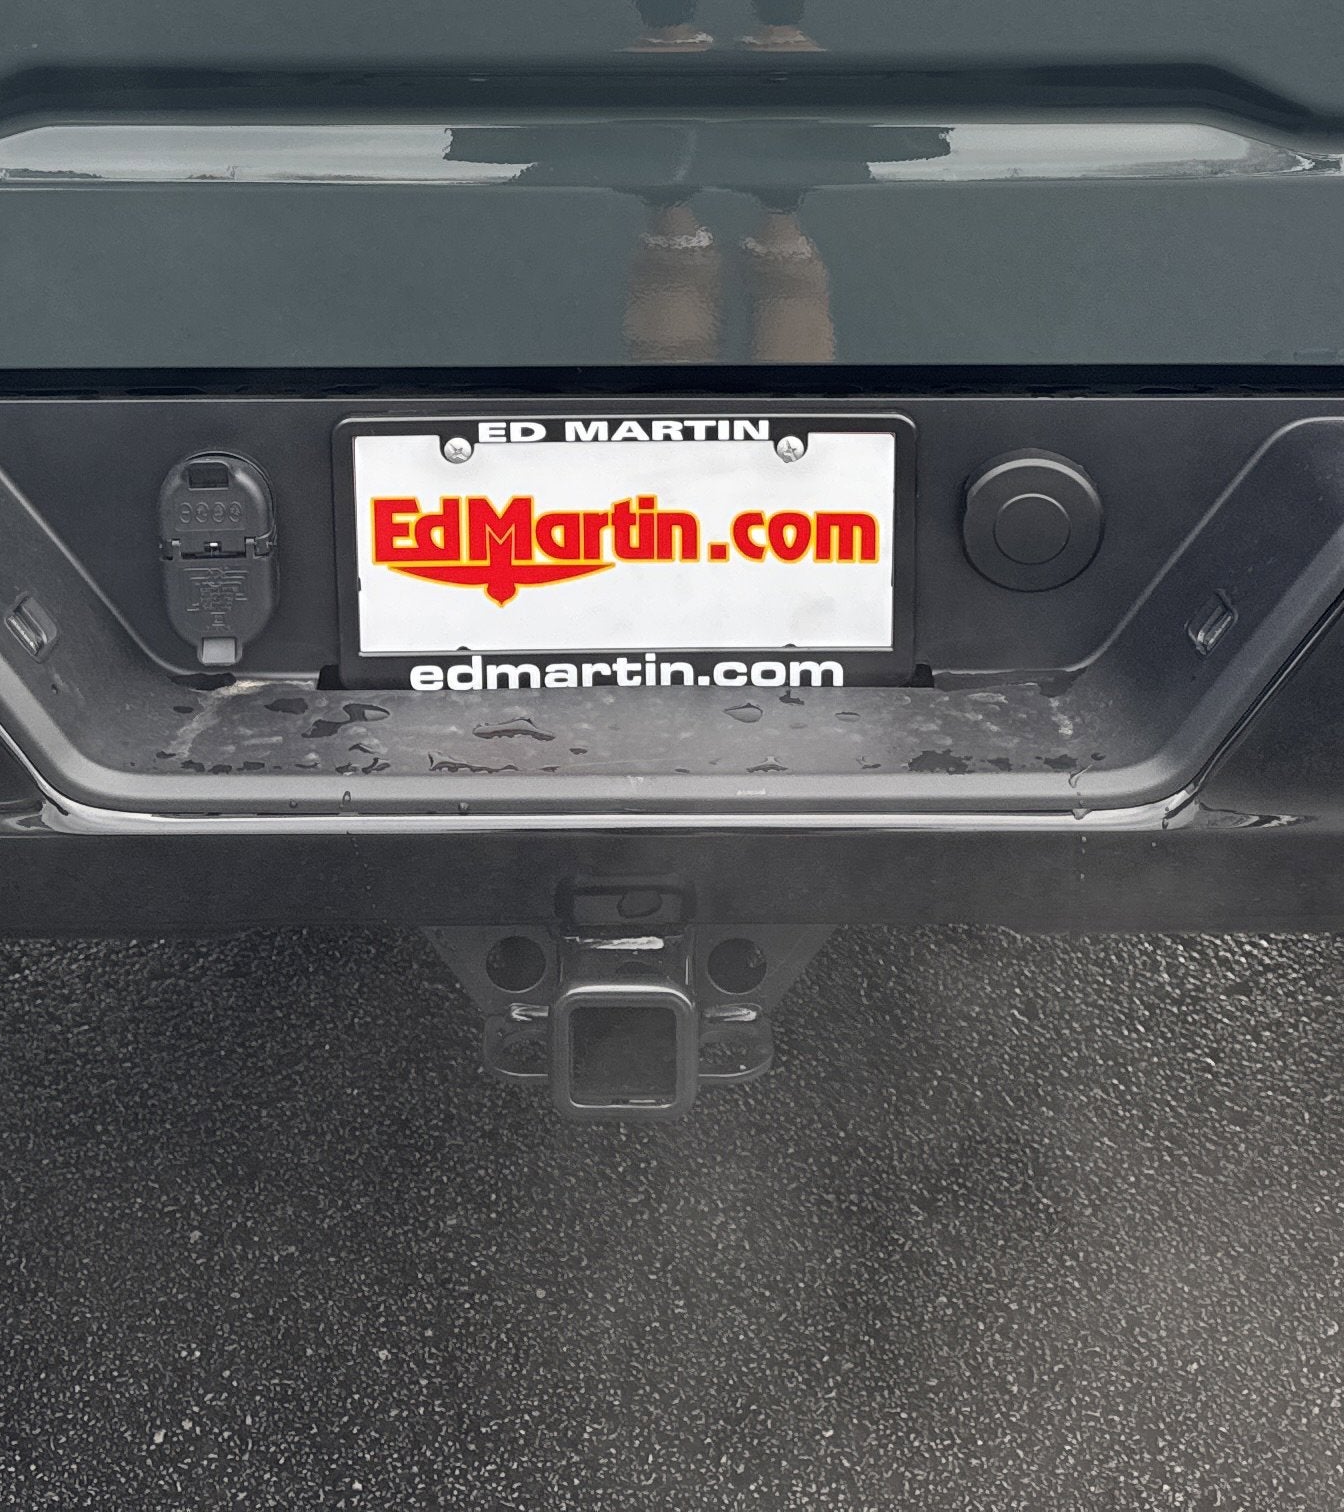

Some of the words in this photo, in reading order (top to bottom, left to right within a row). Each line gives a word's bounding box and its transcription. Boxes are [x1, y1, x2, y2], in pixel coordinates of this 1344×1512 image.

[478, 421, 547, 444] ED
[564, 419, 770, 442] MARTIN
[409, 653, 845, 692] edmartin.com
